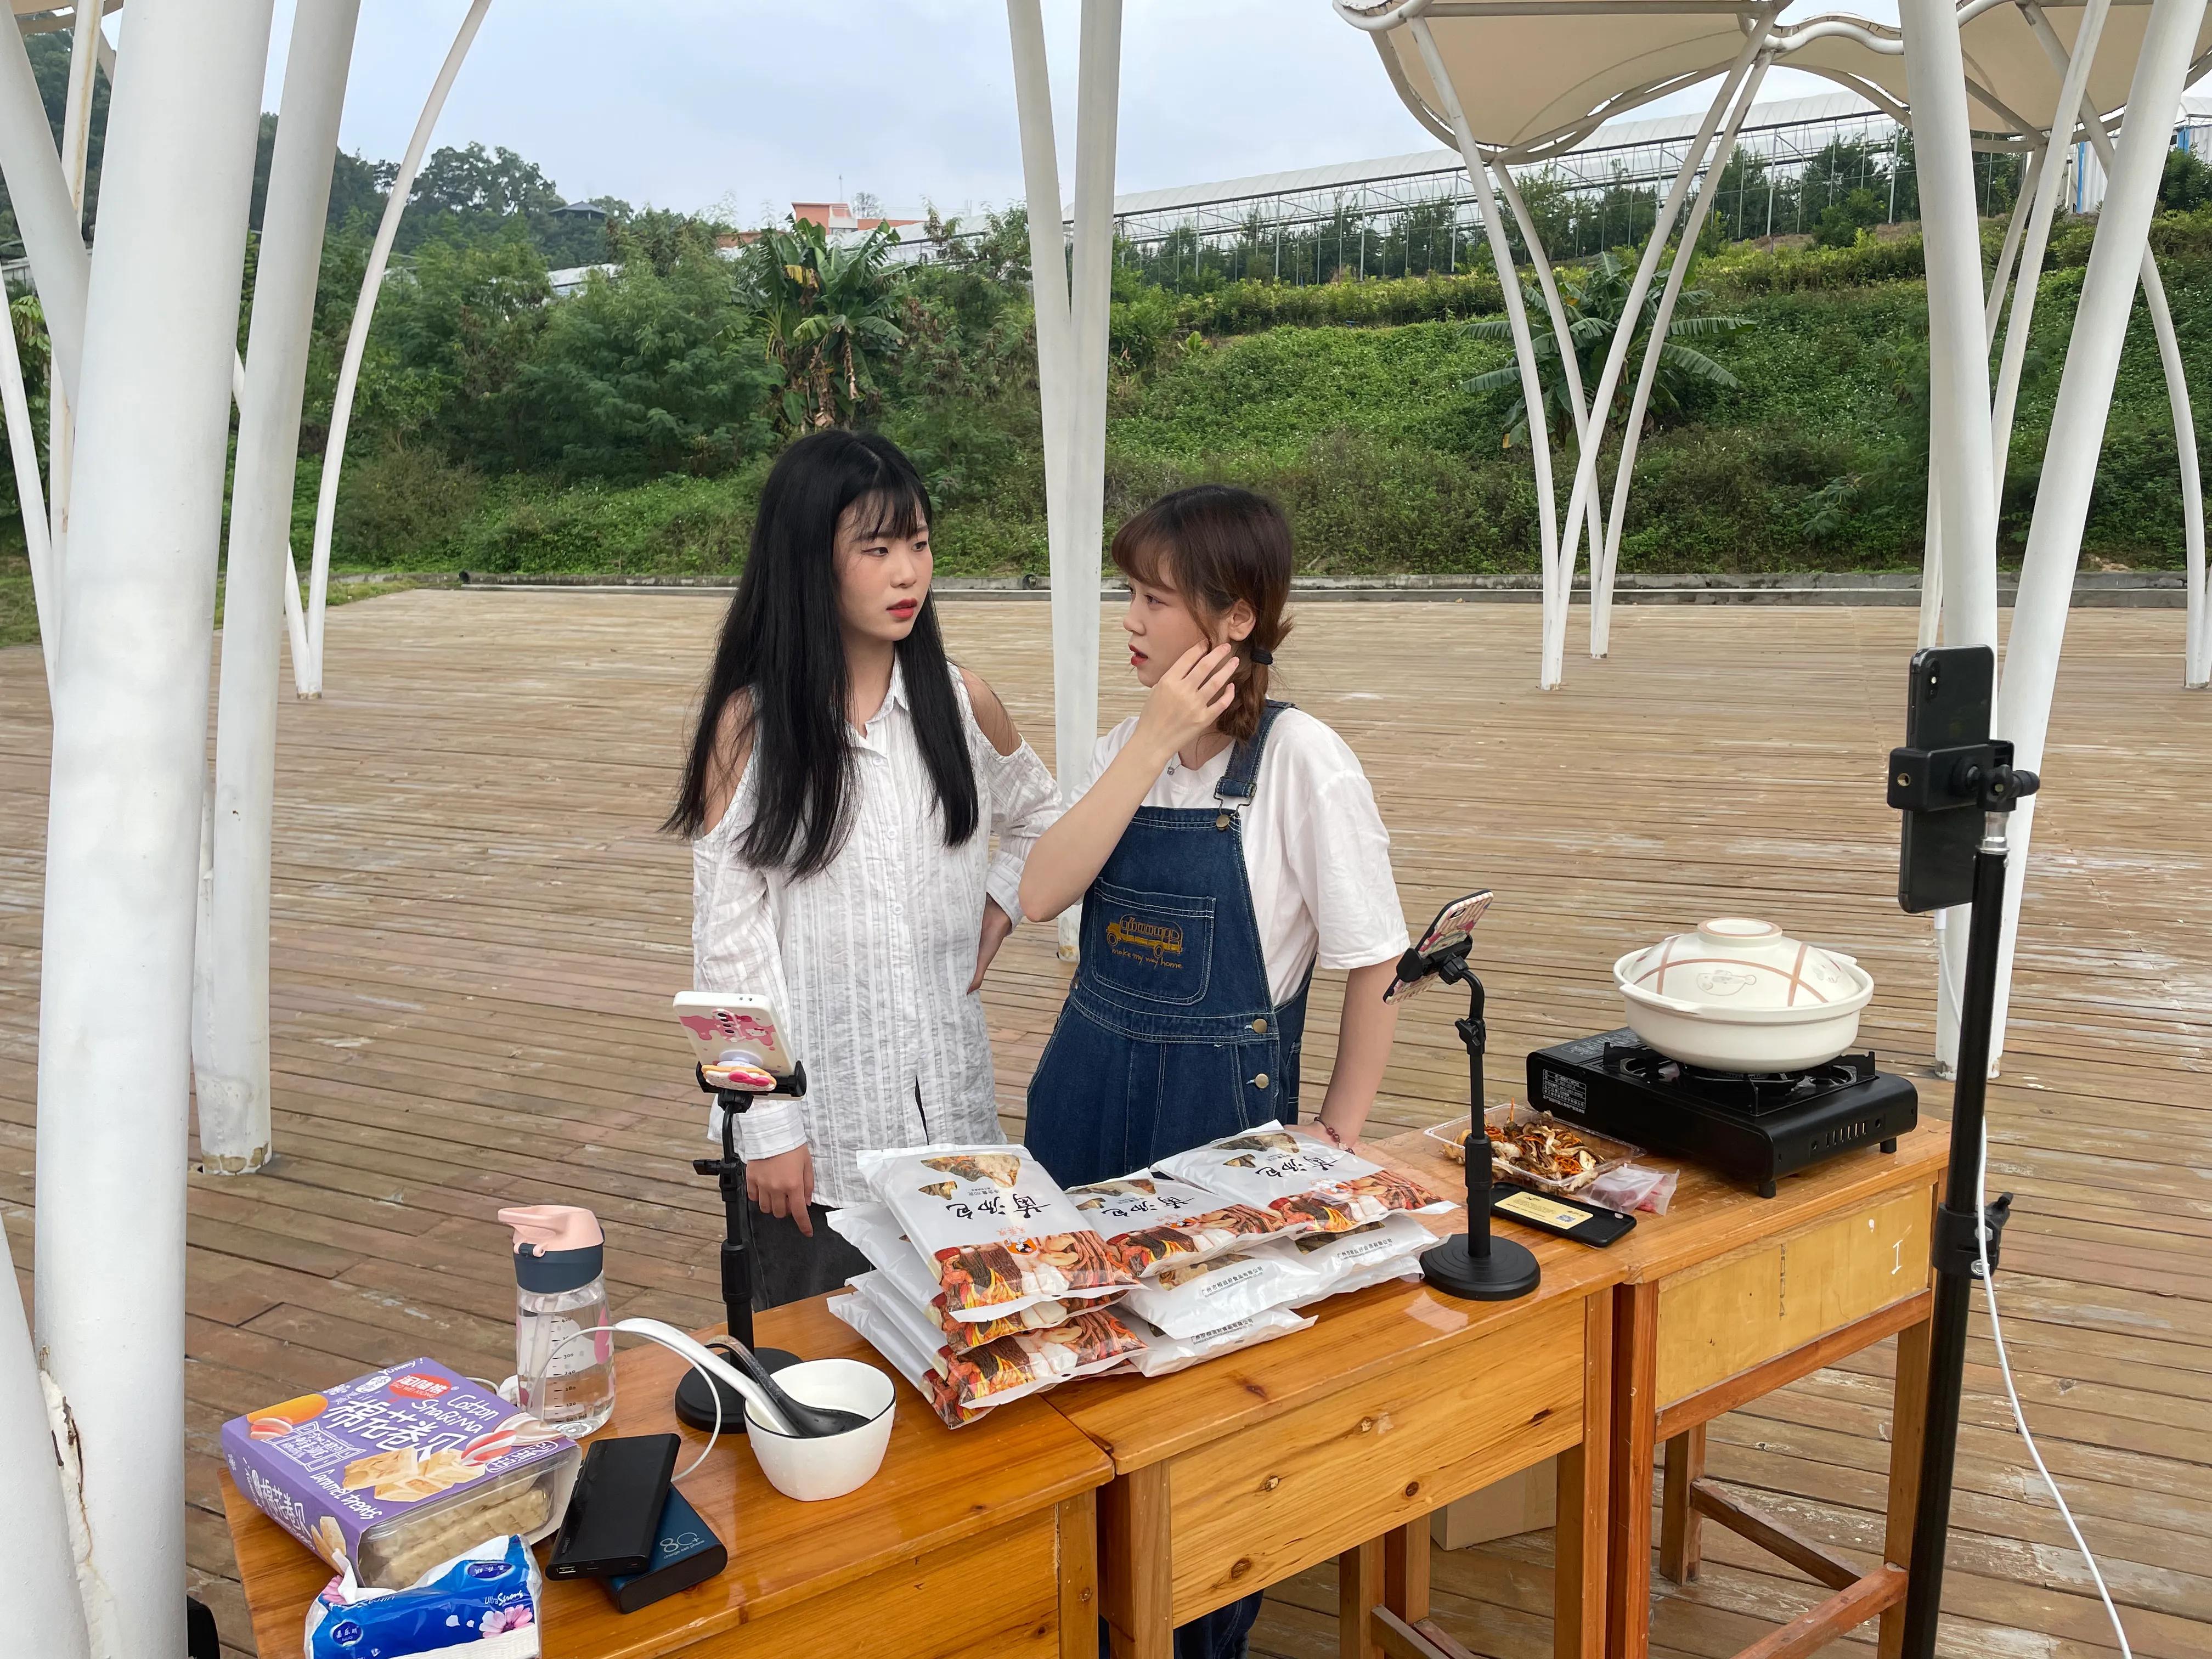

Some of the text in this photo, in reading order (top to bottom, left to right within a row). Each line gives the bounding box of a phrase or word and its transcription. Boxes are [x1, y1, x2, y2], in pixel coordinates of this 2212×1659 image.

[1111, 948, 1183, 969] make my way home
[945, 1193, 1052, 1220] 菌汤包
[1101, 1197, 1195, 1217] 菌汤包
[447, 1395, 499, 1421] Cotton
[309, 1469, 382, 1520] Caramel treats
[690, 1540, 705, 1548] phone
